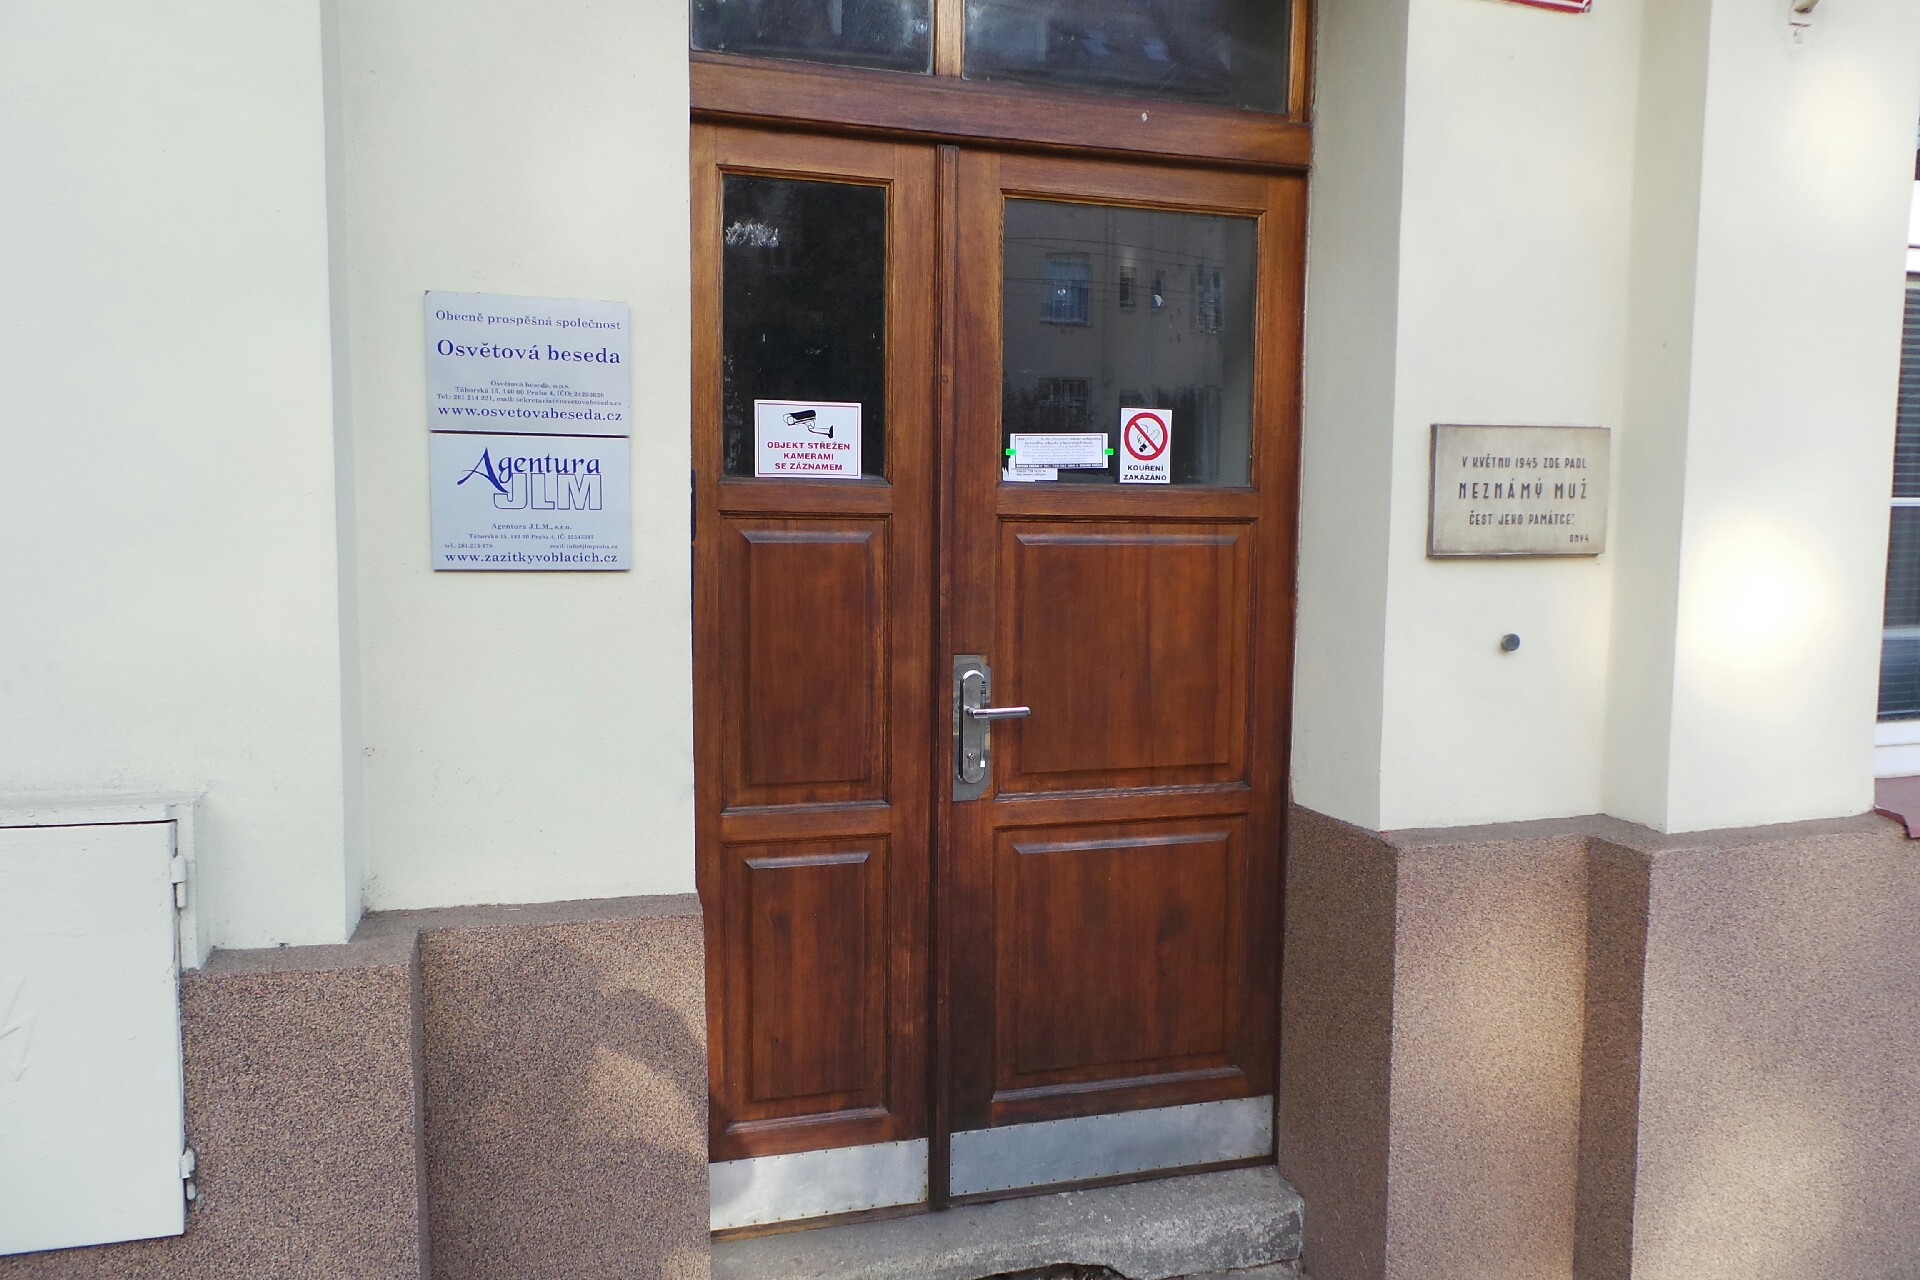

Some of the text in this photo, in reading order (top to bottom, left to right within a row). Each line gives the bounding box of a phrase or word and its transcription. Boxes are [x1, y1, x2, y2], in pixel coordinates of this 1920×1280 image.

[435, 309, 621, 330] Obecně prospěšná společnost
[437, 339, 621, 364] Osvětová beseda
[490, 380, 524, 388] Osvětová
[455, 386, 489, 394] Táborská
[526, 389, 548, 397] Praha
[438, 407, 623, 421] www.osvetovabeseda.cz
[767, 441, 851, 451] OBJEKT STŘEŽEN
[783, 452, 834, 462] KAMERAMI
[1462, 456, 1468, 467] V
[1515, 457, 1538, 468] 1945
[1543, 457, 1560, 468] ZDE
[1564, 457, 1587, 468] PADL
[456, 447, 602, 494] Agentura
[775, 461, 843, 471] SE ZÁZNAMEM
[1127, 464, 1164, 472] KOUŘENÍ
[1123, 473, 1167, 481] ZAKÁZÁNO
[493, 472, 603, 511] JLM
[1458, 477, 1587, 499] NEZNÁMÝ MUŽ
[1469, 510, 1493, 526] ČEST
[1498, 513, 1523, 526] JEHO
[445, 552, 618, 565] www.zazitkyvoblacich.cz
